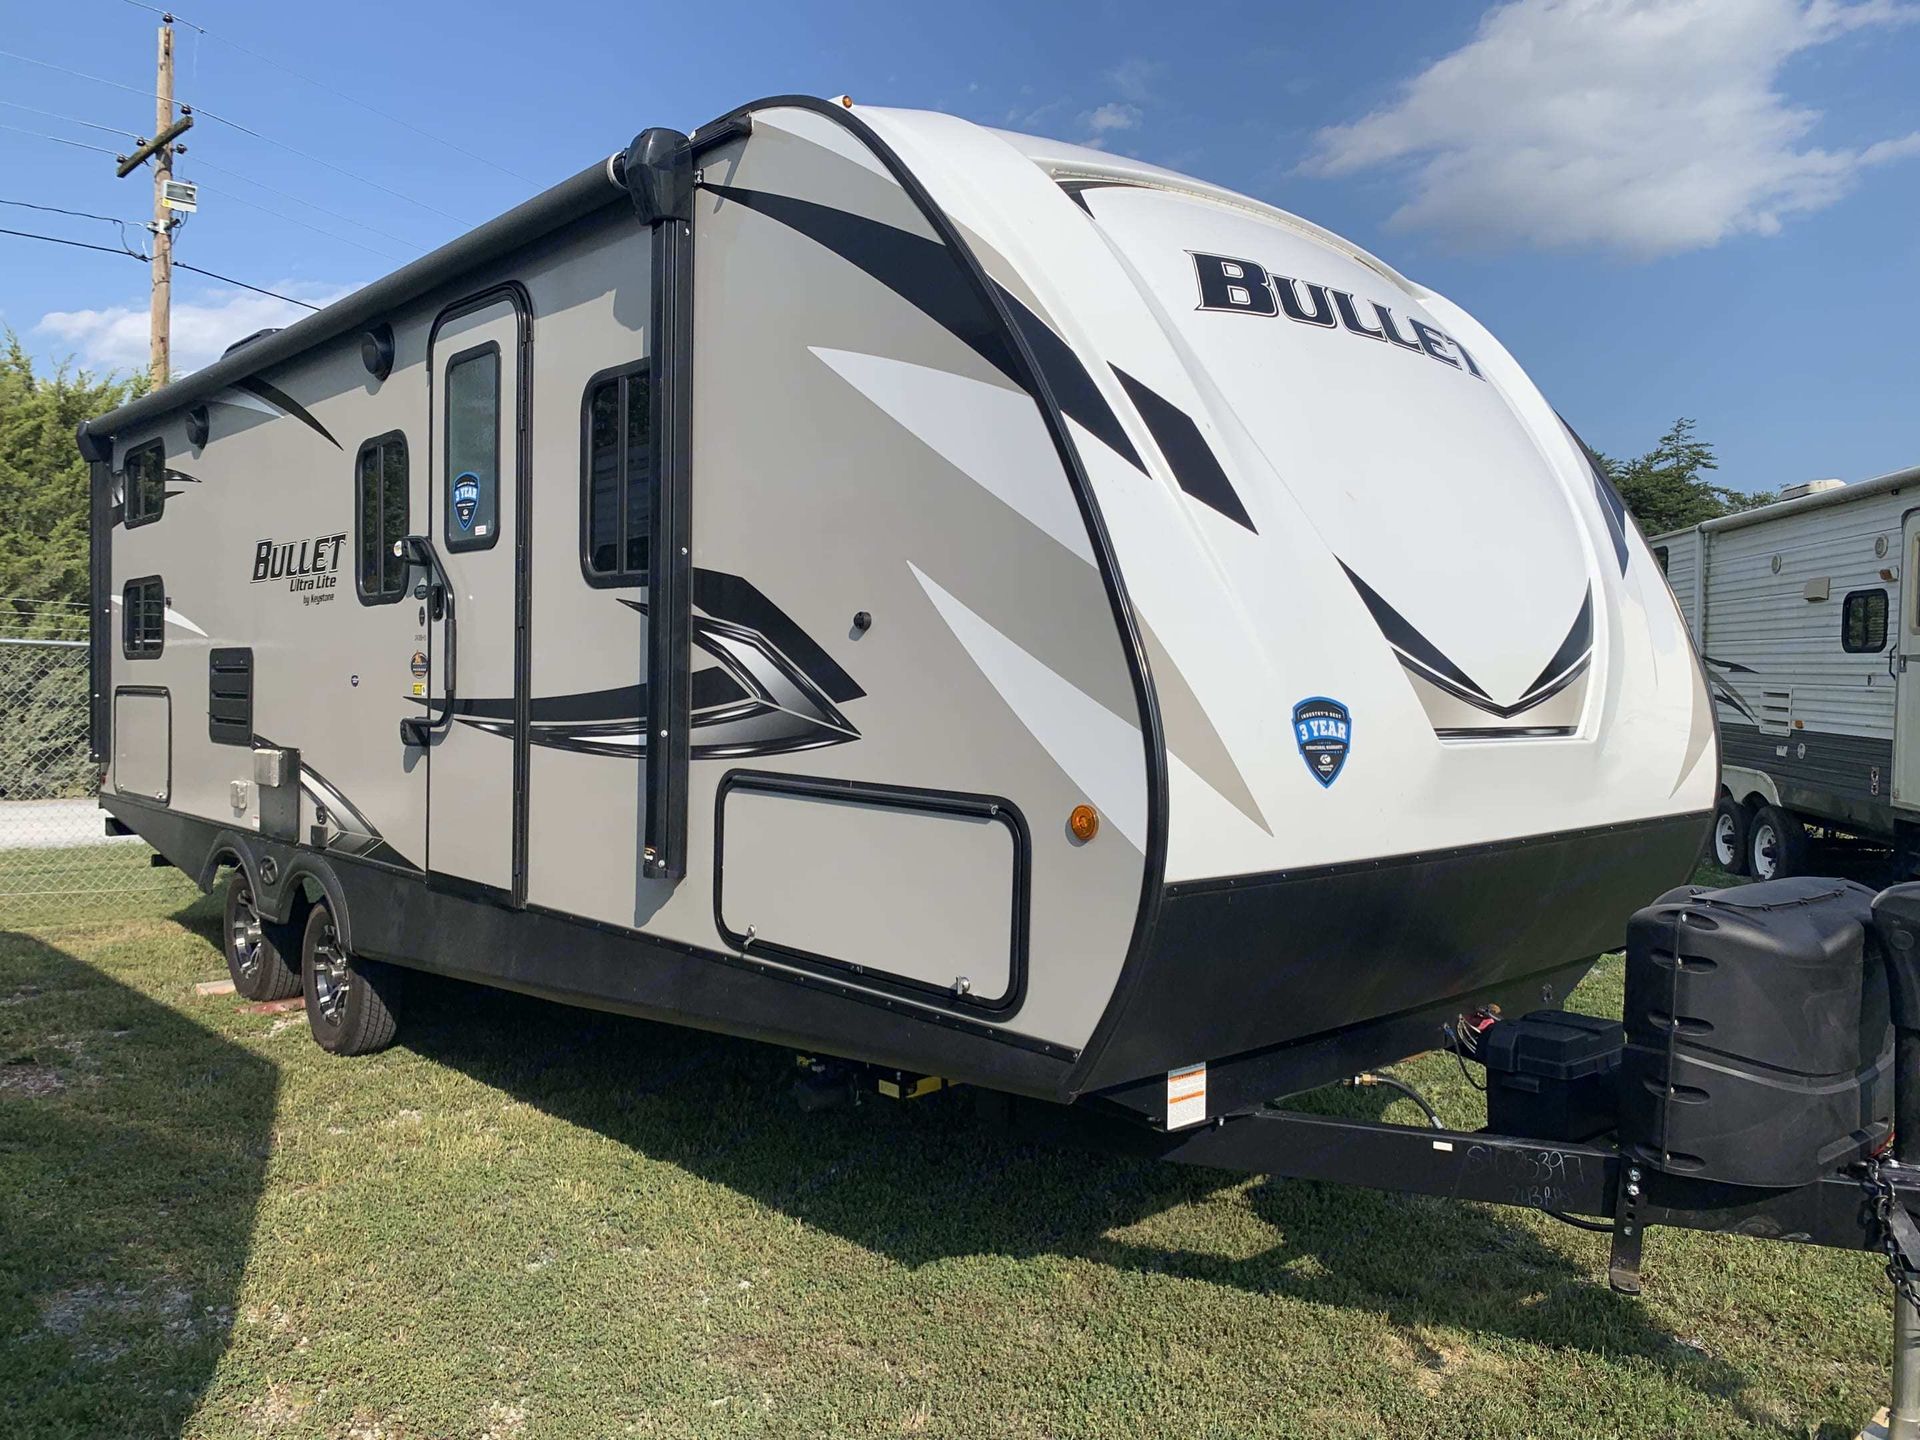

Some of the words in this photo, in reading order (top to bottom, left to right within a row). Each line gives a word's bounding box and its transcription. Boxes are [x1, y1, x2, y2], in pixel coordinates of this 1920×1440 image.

[1183, 249, 1487, 382] BULLET
[250, 531, 348, 583] BULLET
[290, 578, 314, 592] Ultra
[316, 575, 337, 589] Lite
[303, 594, 311, 606] by
[311, 593, 335, 605] Keystone
[1299, 723, 1309, 740] 3
[1310, 719, 1346, 739] YEAR
